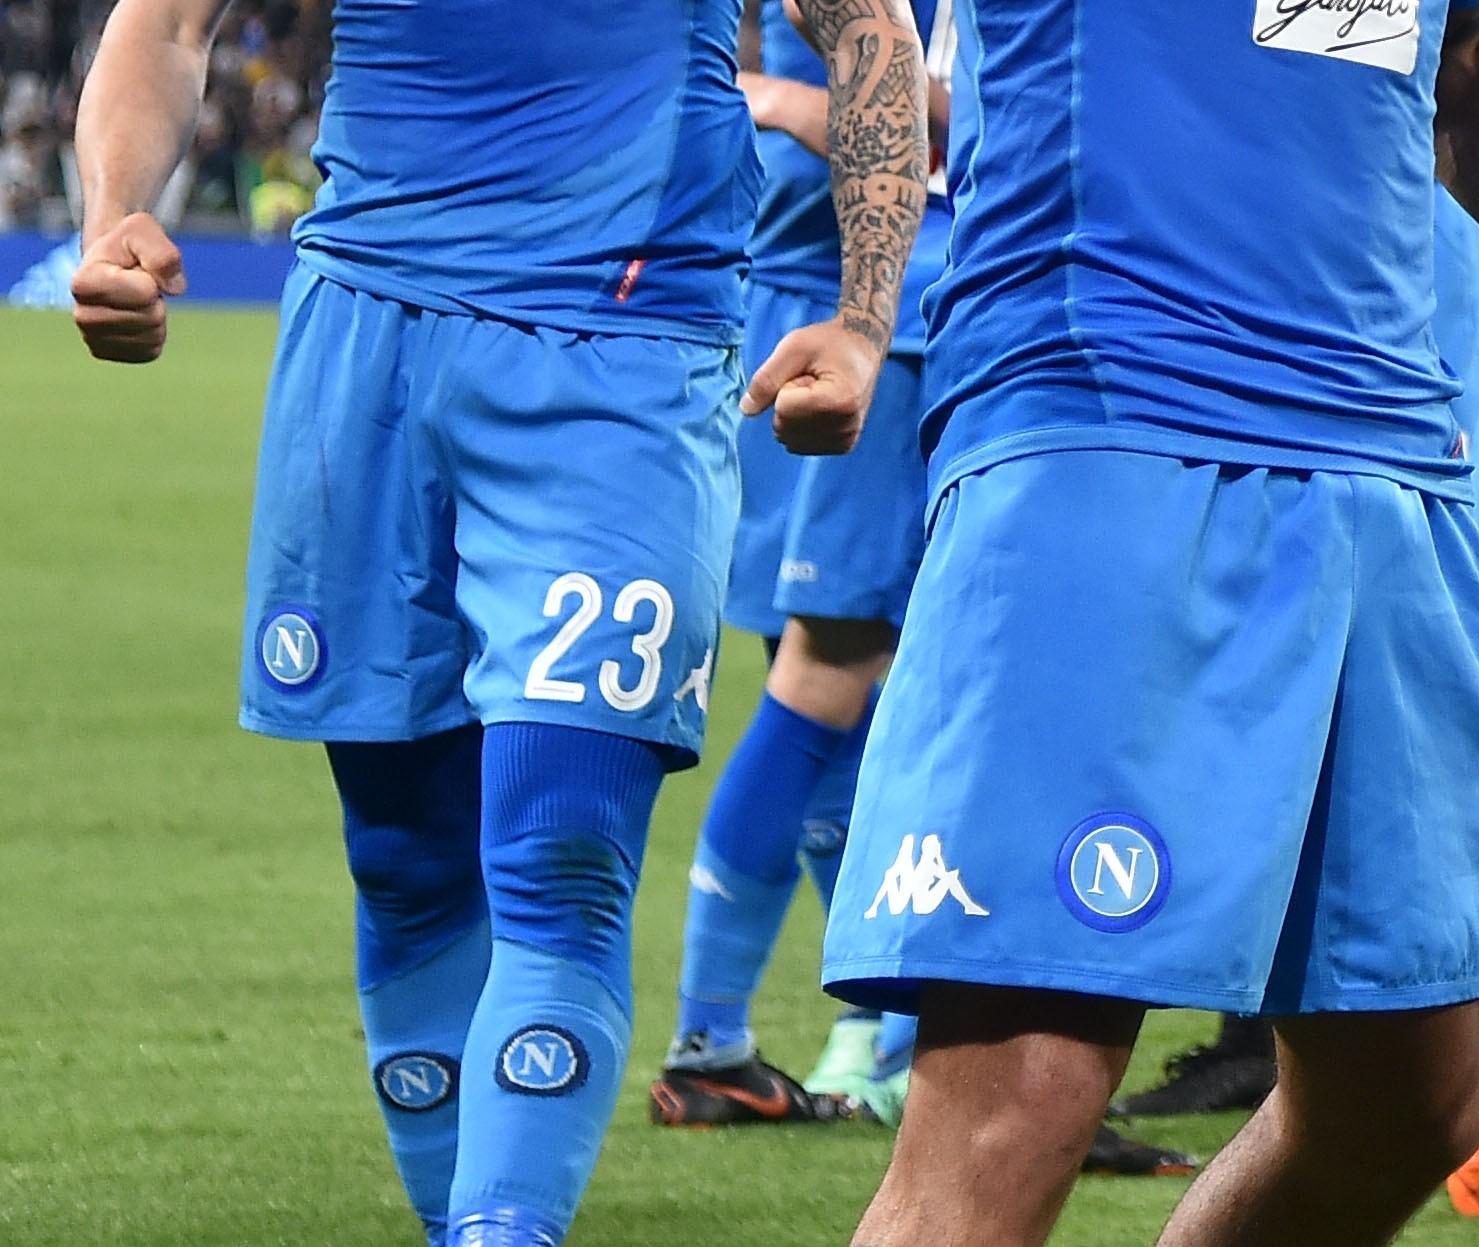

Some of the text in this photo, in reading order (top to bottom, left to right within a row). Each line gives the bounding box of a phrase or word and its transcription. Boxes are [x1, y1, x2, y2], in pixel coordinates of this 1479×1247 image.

[273, 627, 306, 671] N
[524, 572, 674, 711] 23
[1089, 843, 1141, 901] N
[524, 1046, 559, 1075] N
